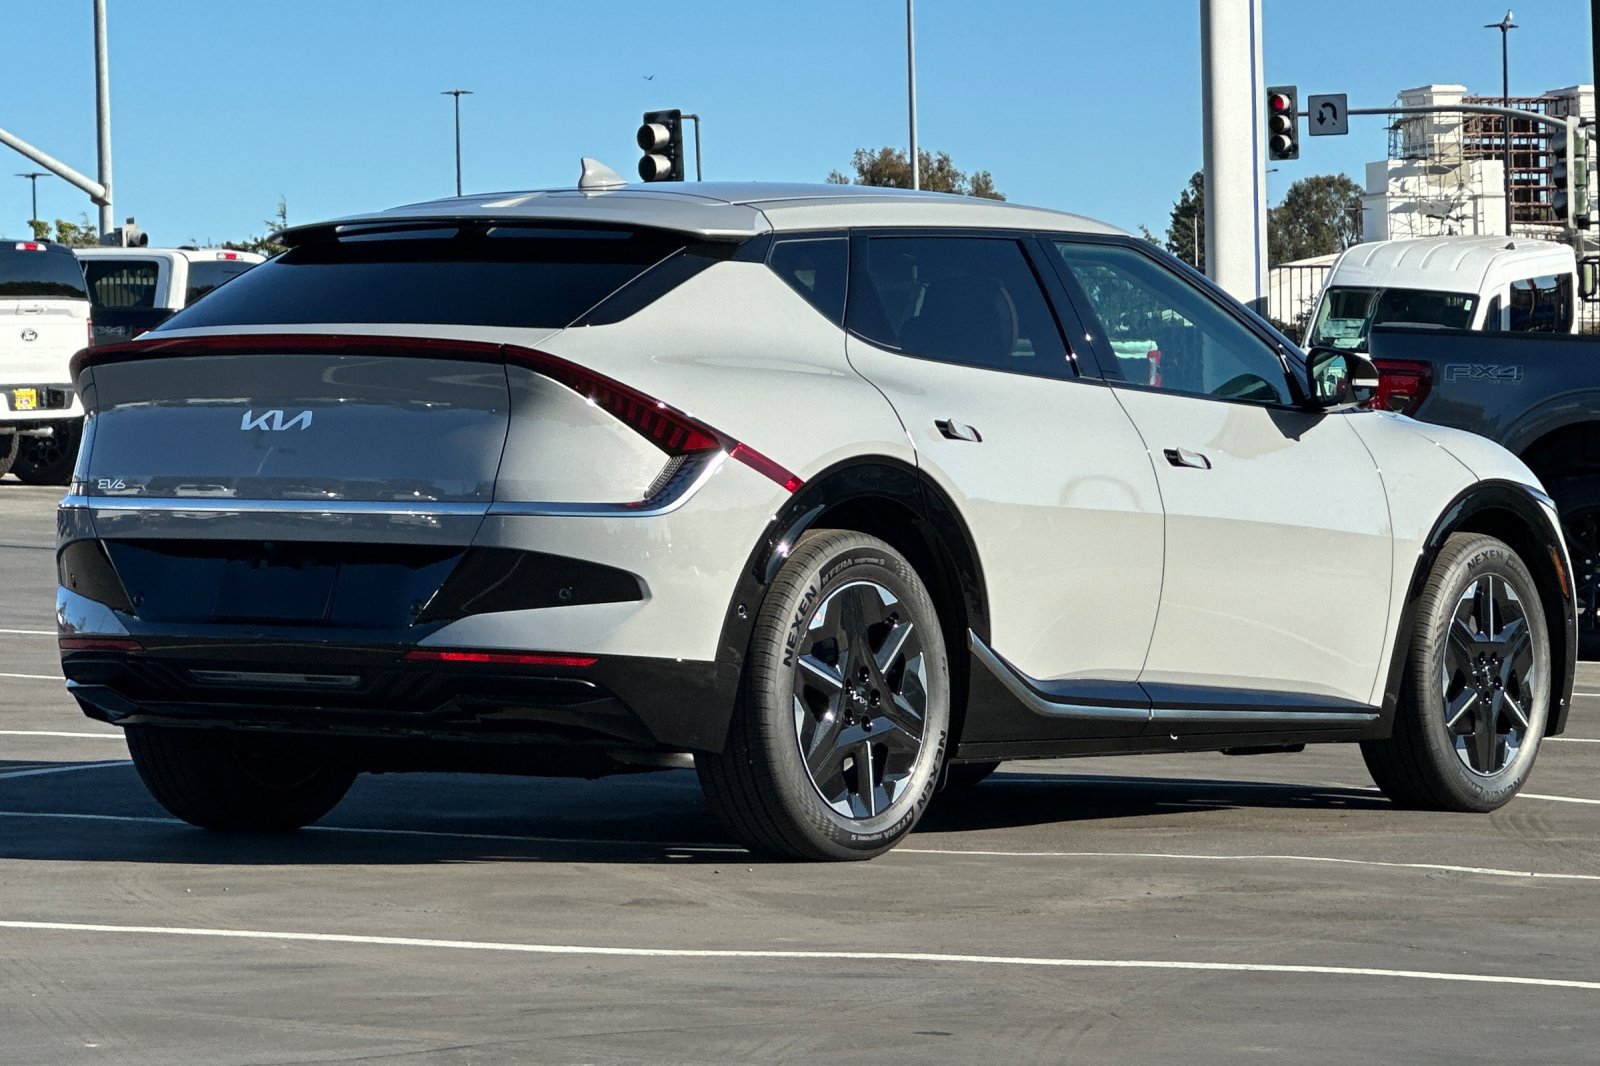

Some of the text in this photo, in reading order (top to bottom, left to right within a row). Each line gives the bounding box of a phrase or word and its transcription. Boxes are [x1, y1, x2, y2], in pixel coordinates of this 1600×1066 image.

[1444, 364, 1523, 383] FX4
[240, 409, 313, 431] KIA
[98, 478, 126, 489] EV6
[1467, 549, 1504, 572] NEXEN
[783, 585, 818, 667] NEXEN
[917, 730, 947, 808] NEXEN
